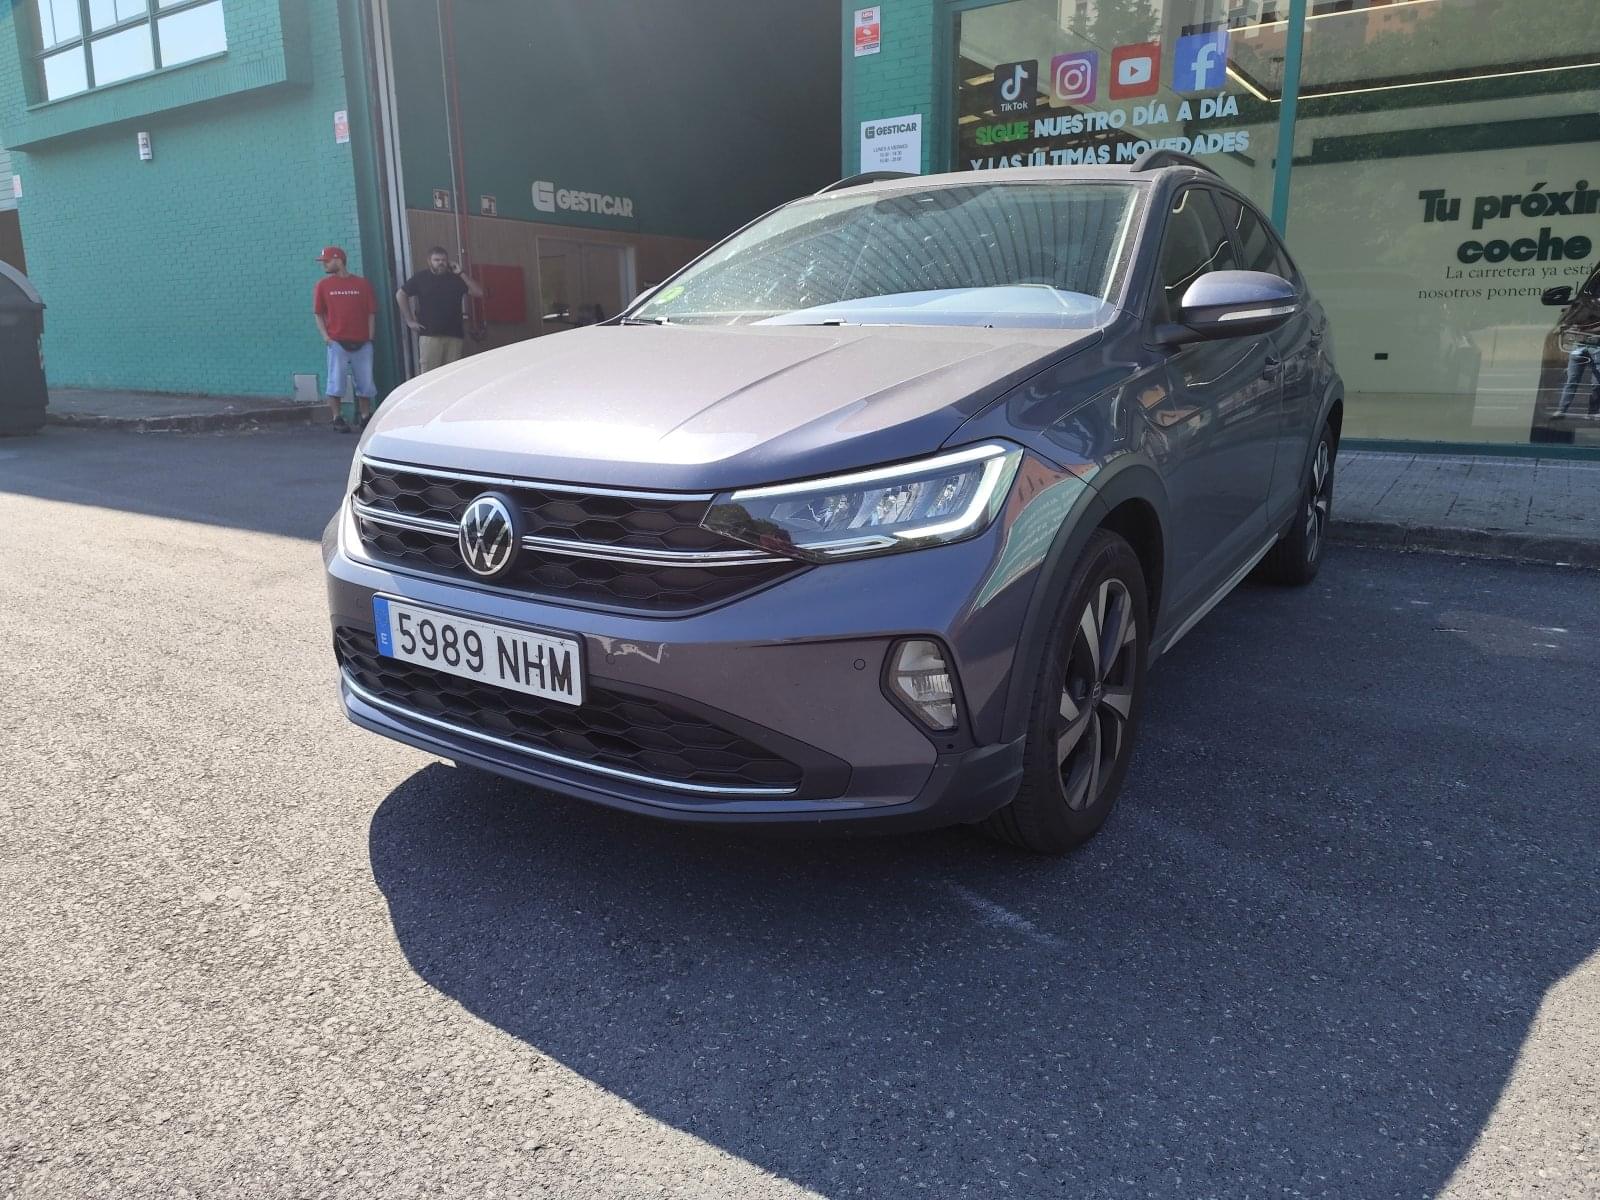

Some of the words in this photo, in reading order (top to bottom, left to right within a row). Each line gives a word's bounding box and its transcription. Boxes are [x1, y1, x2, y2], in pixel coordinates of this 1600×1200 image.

[975, 120, 1029, 145] SIGUE
[1034, 109, 1127, 138] NUESTRO
[1133, 99, 1169, 126] DÍA
[1176, 100, 1193, 122] A
[1200, 91, 1239, 120] DÍA
[1000, 100, 1028, 112] TikTok
[876, 122, 917, 136] GESTICAR
[970, 158, 983, 170] Y
[988, 154, 1022, 169] LAS
[1028, 145, 1111, 167] ÚLTIMAS
[556, 189, 634, 218] GESTICAR
[1418, 189, 1461, 223] Tu
[1457, 227, 1592, 264] coche
[1446, 266, 1463, 279] La
[1468, 267, 1535, 278] carretera
[1541, 266, 1557, 279] ya
[1563, 263, 1593, 276] está
[1418, 286, 1482, 299] nosotros
[1487, 285, 1547, 300] ponem
[398, 612, 484, 673] 5989
[497, 635, 573, 696] NHM
